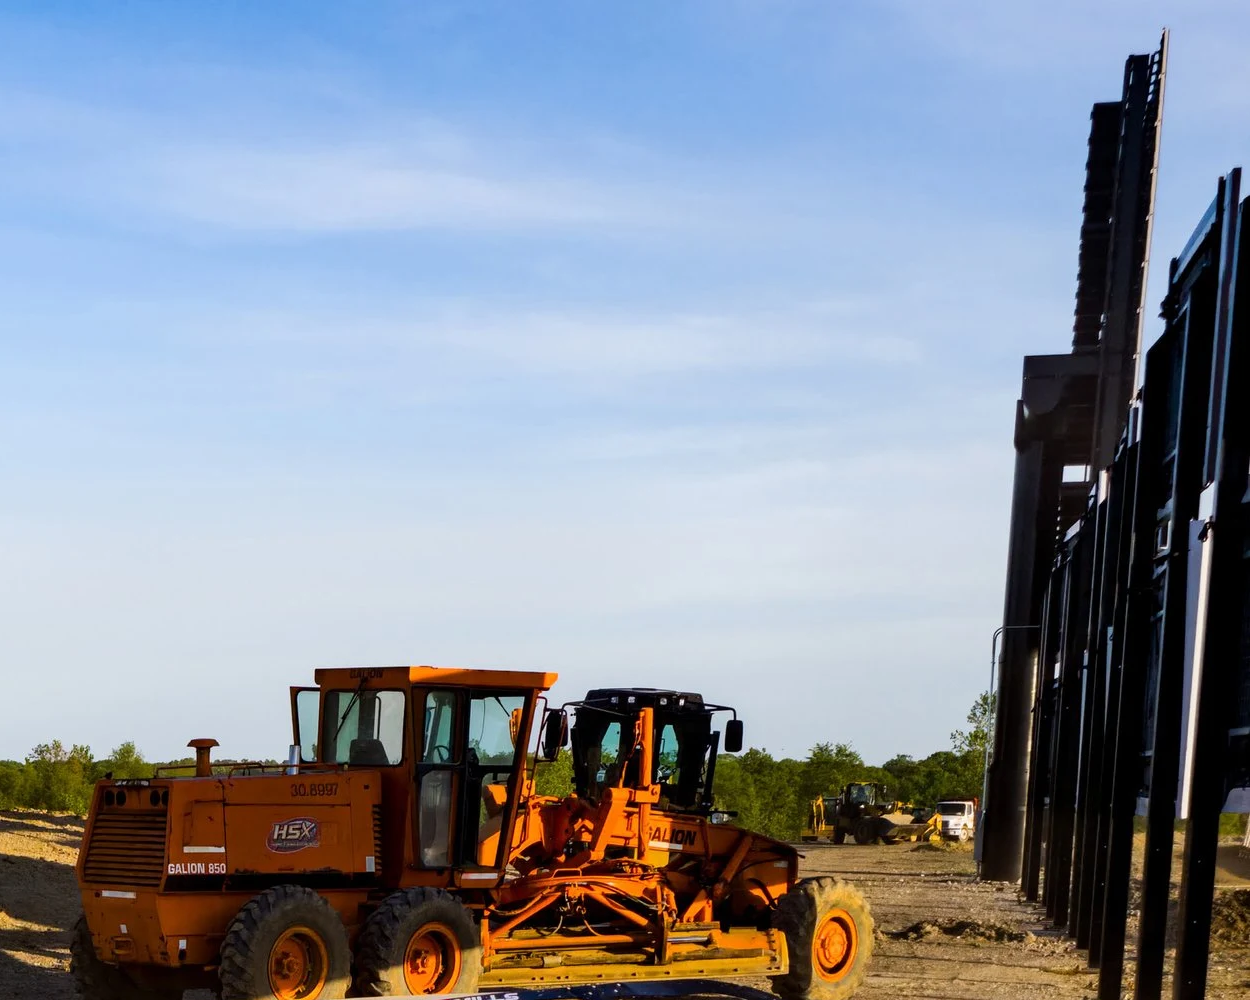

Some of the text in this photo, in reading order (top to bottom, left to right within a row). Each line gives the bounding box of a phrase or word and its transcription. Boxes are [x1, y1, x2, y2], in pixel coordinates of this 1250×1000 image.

[291, 783, 338, 797] 30.8997
[273, 822, 316, 840] HSX
[168, 863, 226, 875] GALION 850
